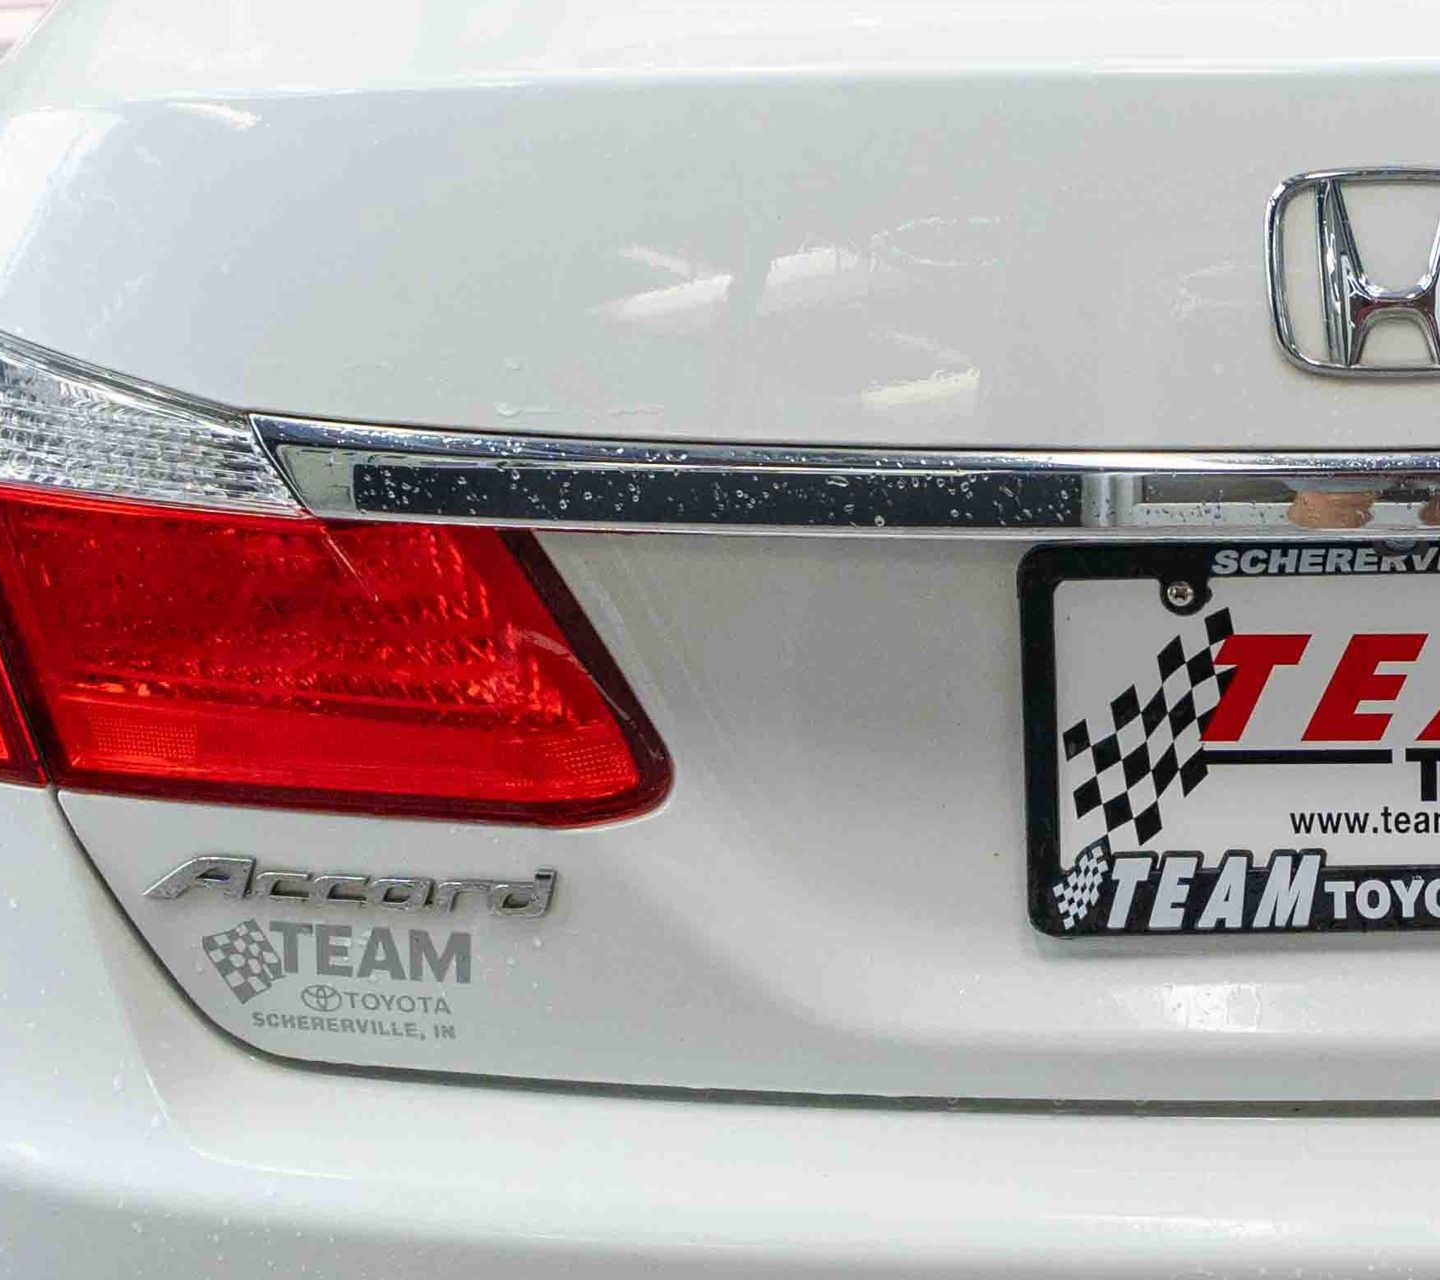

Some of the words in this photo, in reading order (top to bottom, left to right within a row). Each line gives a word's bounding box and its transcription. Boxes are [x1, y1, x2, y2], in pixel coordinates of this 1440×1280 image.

[142, 855, 558, 919] Accord
[1106, 854, 1323, 929] TEAM
[269, 920, 471, 984] TEAM
[251, 1011, 426, 1040] SCHERERVILLE,
[434, 1025, 456, 1040] IN
[343, 991, 452, 1015] TOYOTA
